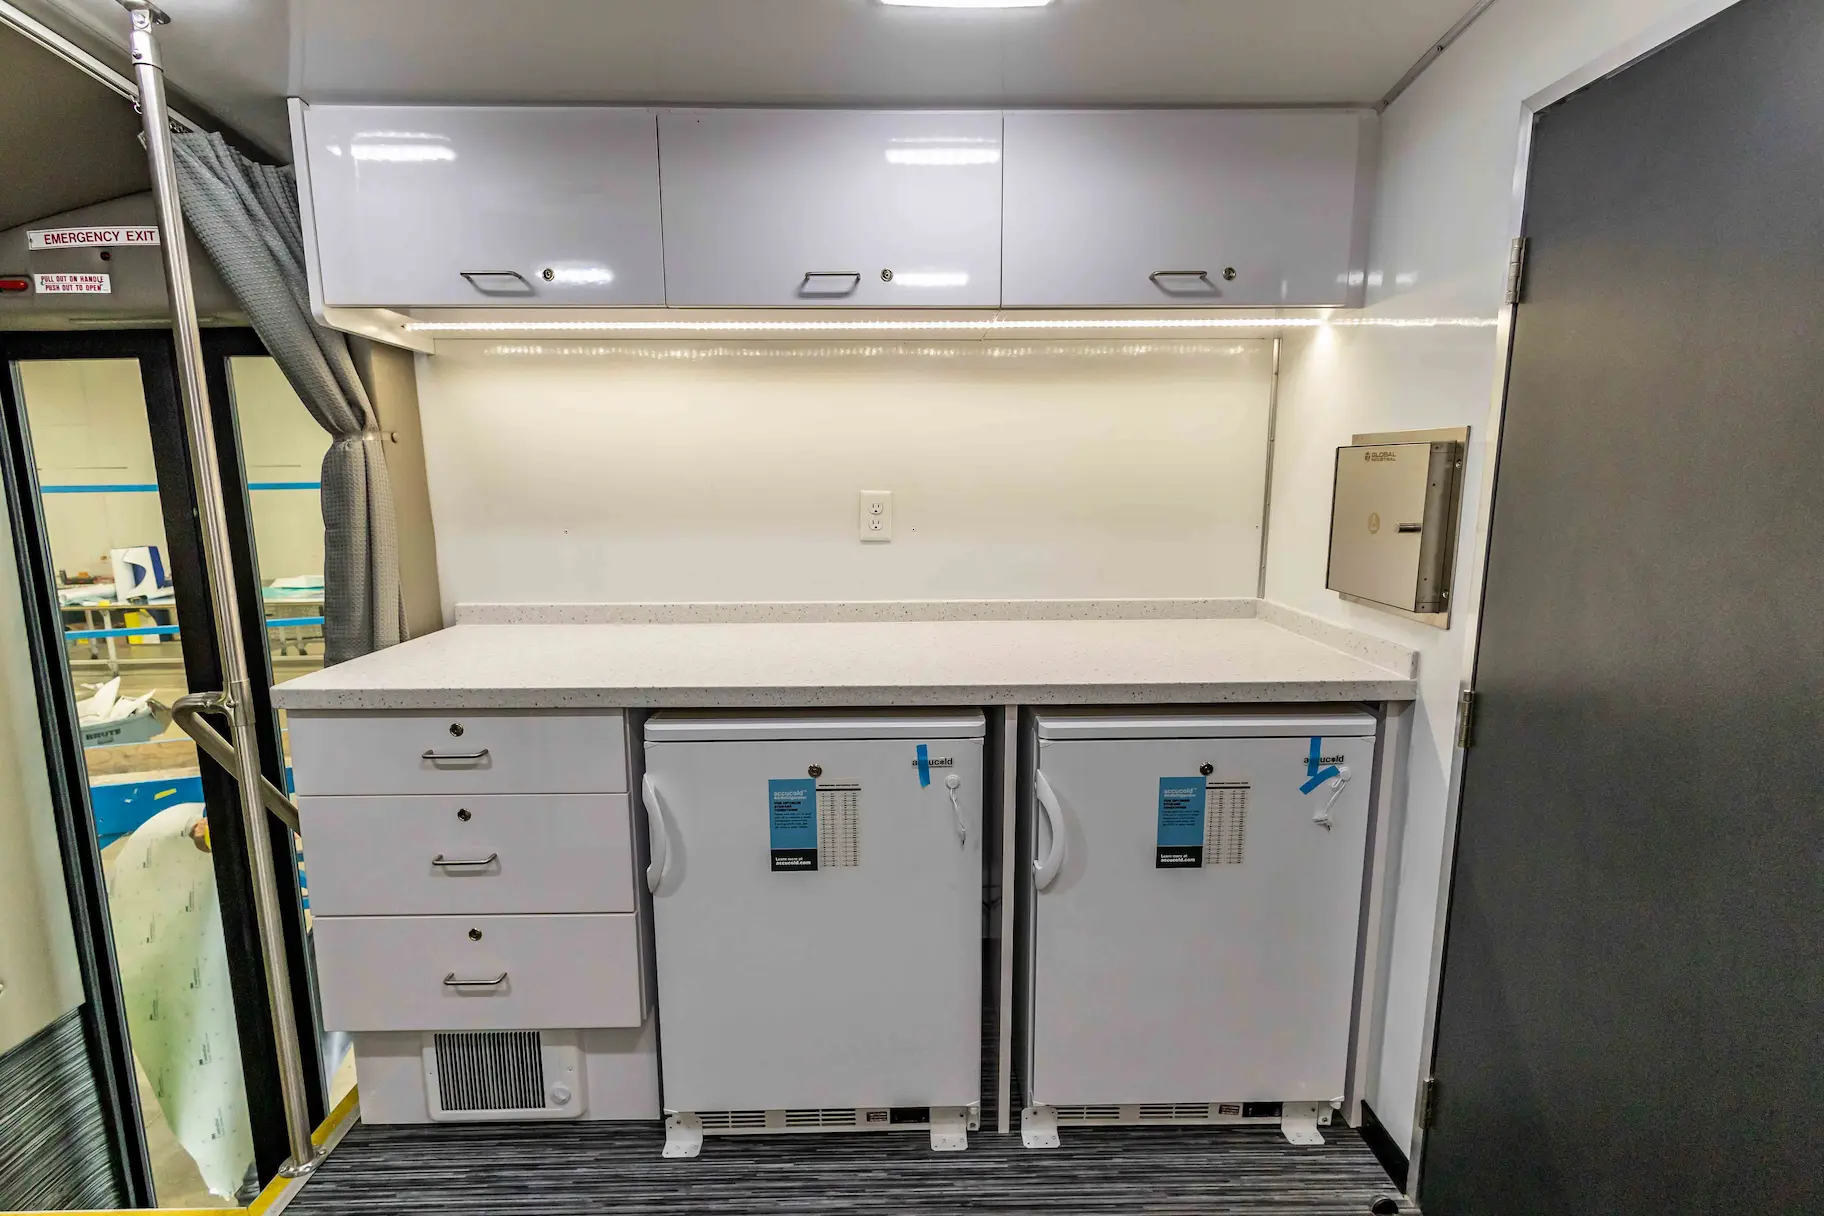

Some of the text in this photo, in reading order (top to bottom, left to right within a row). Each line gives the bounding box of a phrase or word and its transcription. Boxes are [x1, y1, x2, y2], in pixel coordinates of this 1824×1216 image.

[44, 230, 155, 245] EMERGENCY EXIT
[41, 275, 104, 283] PULL OUT ON HANDLE
[86, 728, 121, 740] BRUTE
[912, 757, 953, 766] aucold
[1303, 754, 1344, 763] aucold
